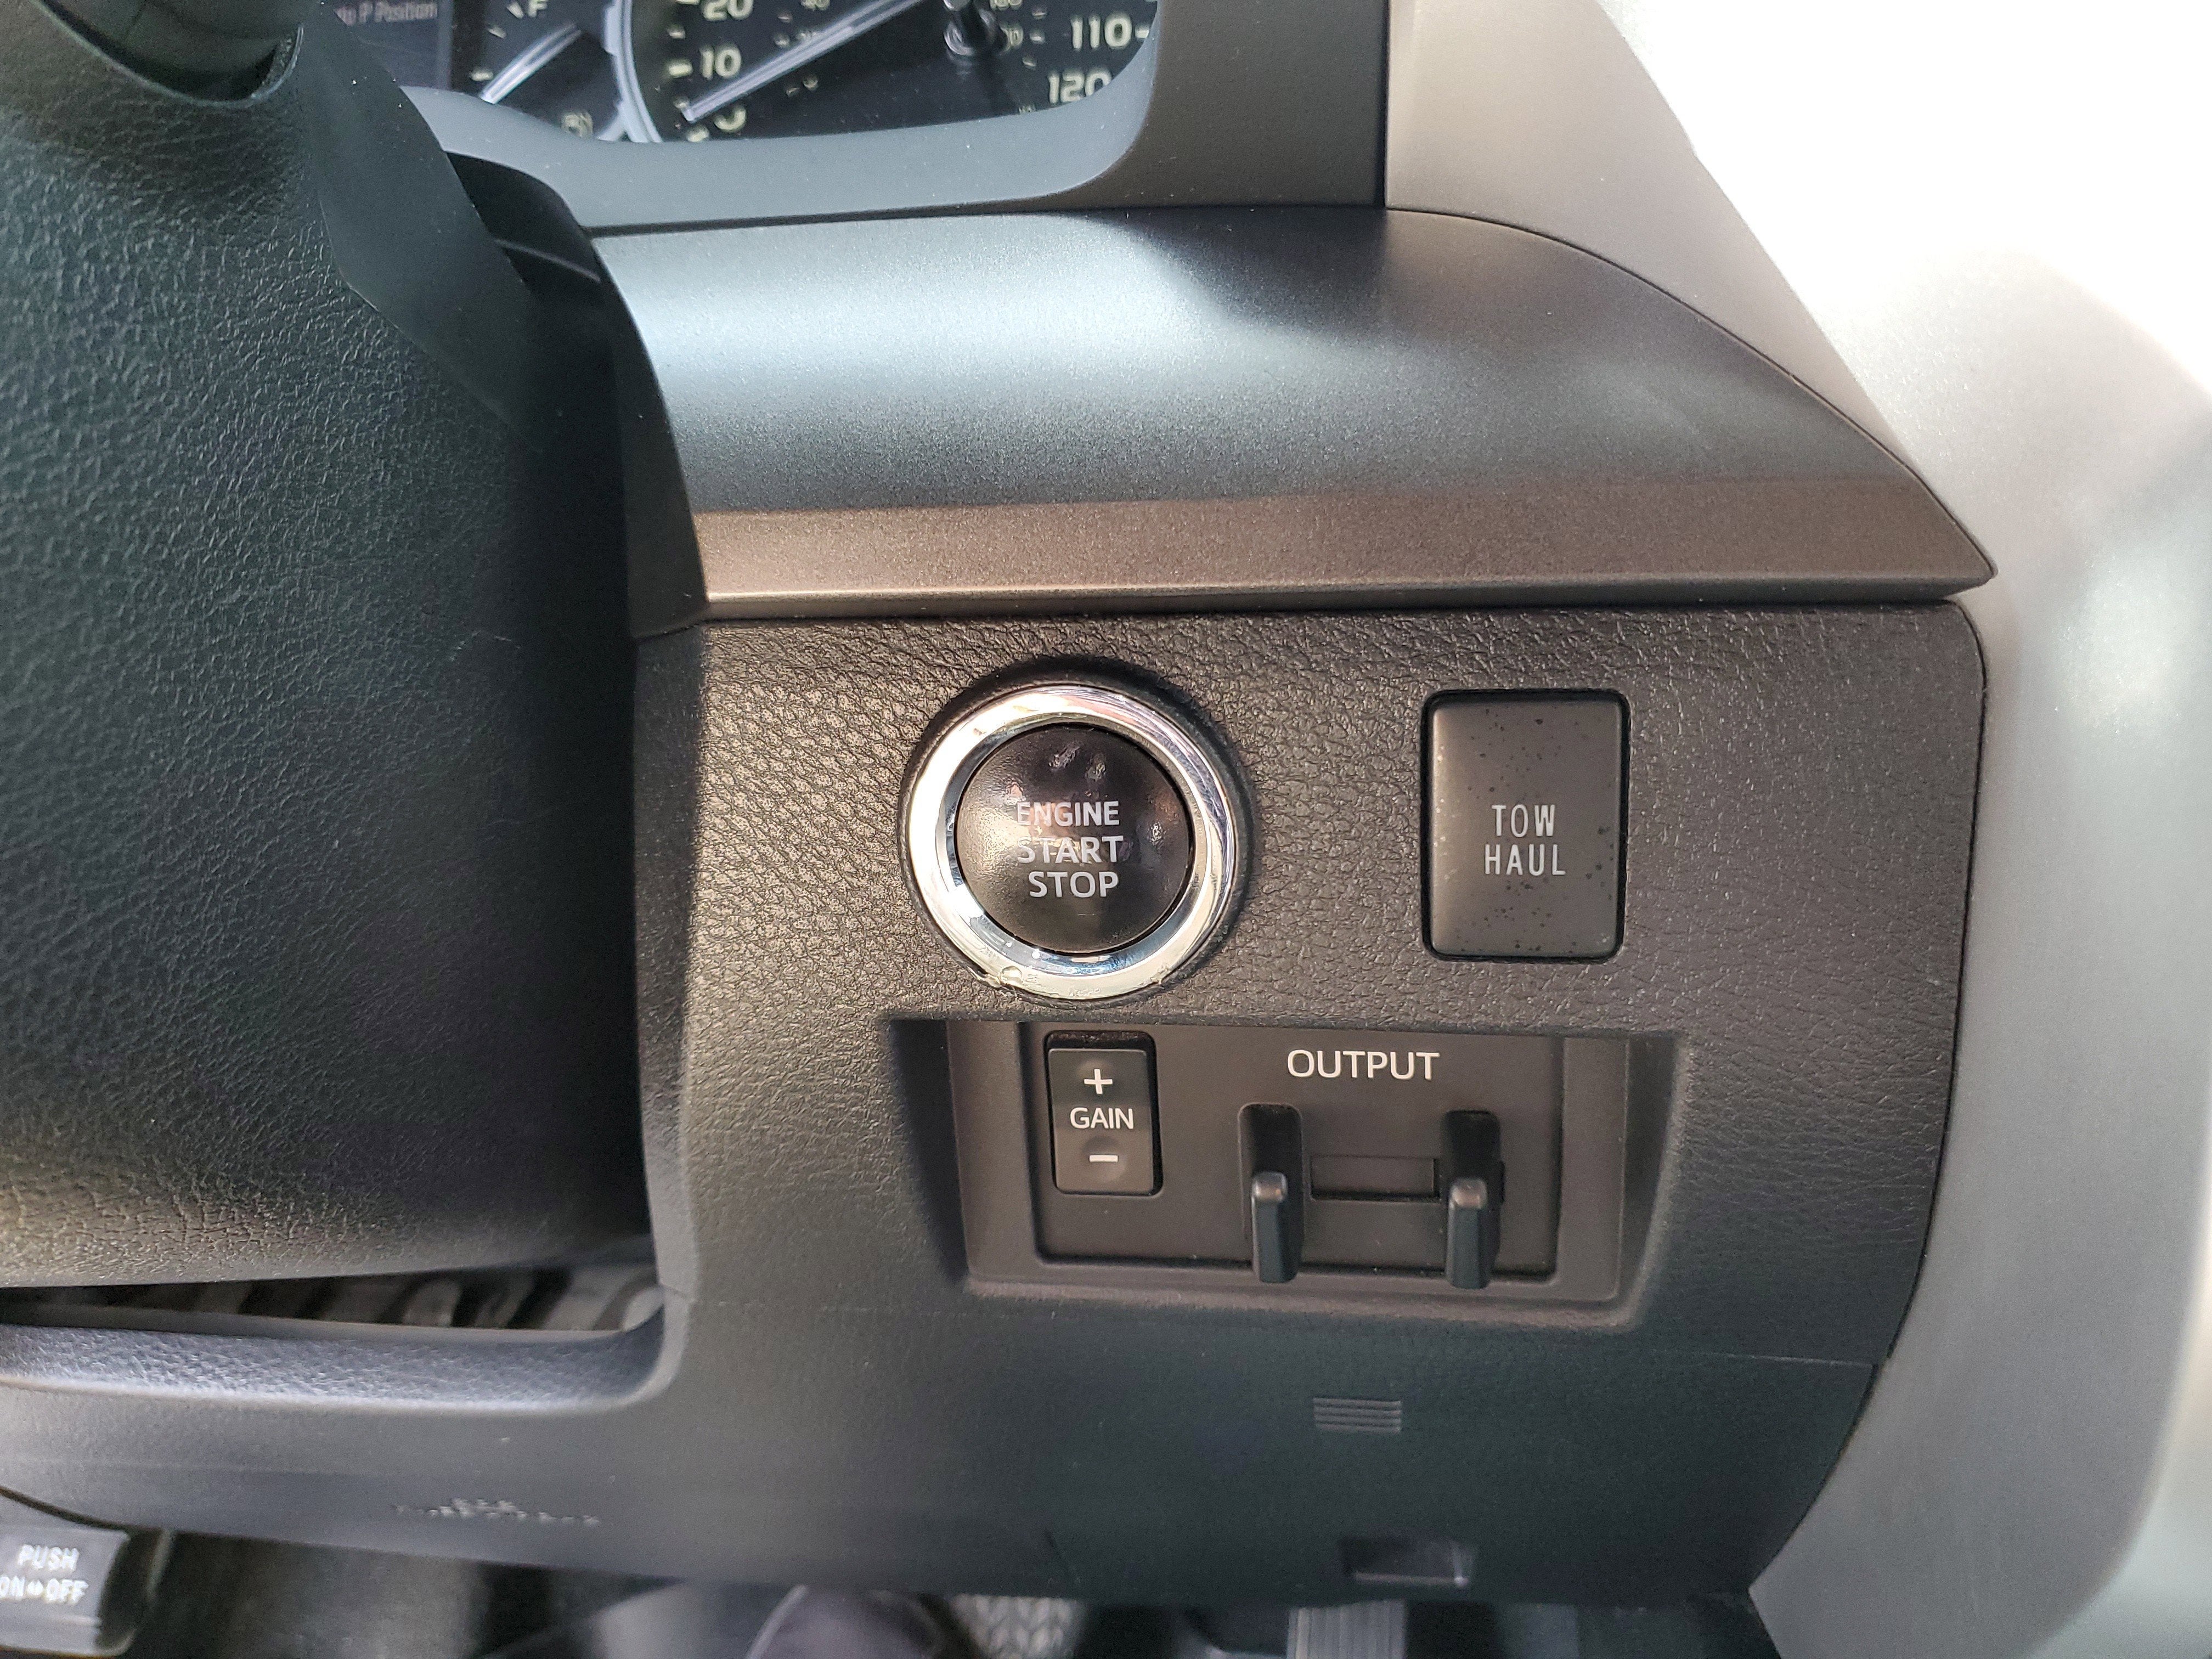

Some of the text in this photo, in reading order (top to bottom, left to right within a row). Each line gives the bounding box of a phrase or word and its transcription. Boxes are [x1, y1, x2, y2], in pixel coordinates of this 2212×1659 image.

[703, 0, 753, 21] 20
[1071, 14, 1132, 50] 110
[701, 43, 742, 80] 10
[1048, 67, 1113, 104] 120
[1016, 800, 1120, 826] ENGINE
[1491, 804, 1556, 838] TOW
[1017, 835, 1124, 864] START
[1484, 843, 1566, 877] HAUL
[1029, 871, 1119, 899] STOP
[1286, 1048, 1440, 1081] OUTPUT
[1069, 1107, 1135, 1130] GAIN
[17, 1544, 80, 1571] PUSH
